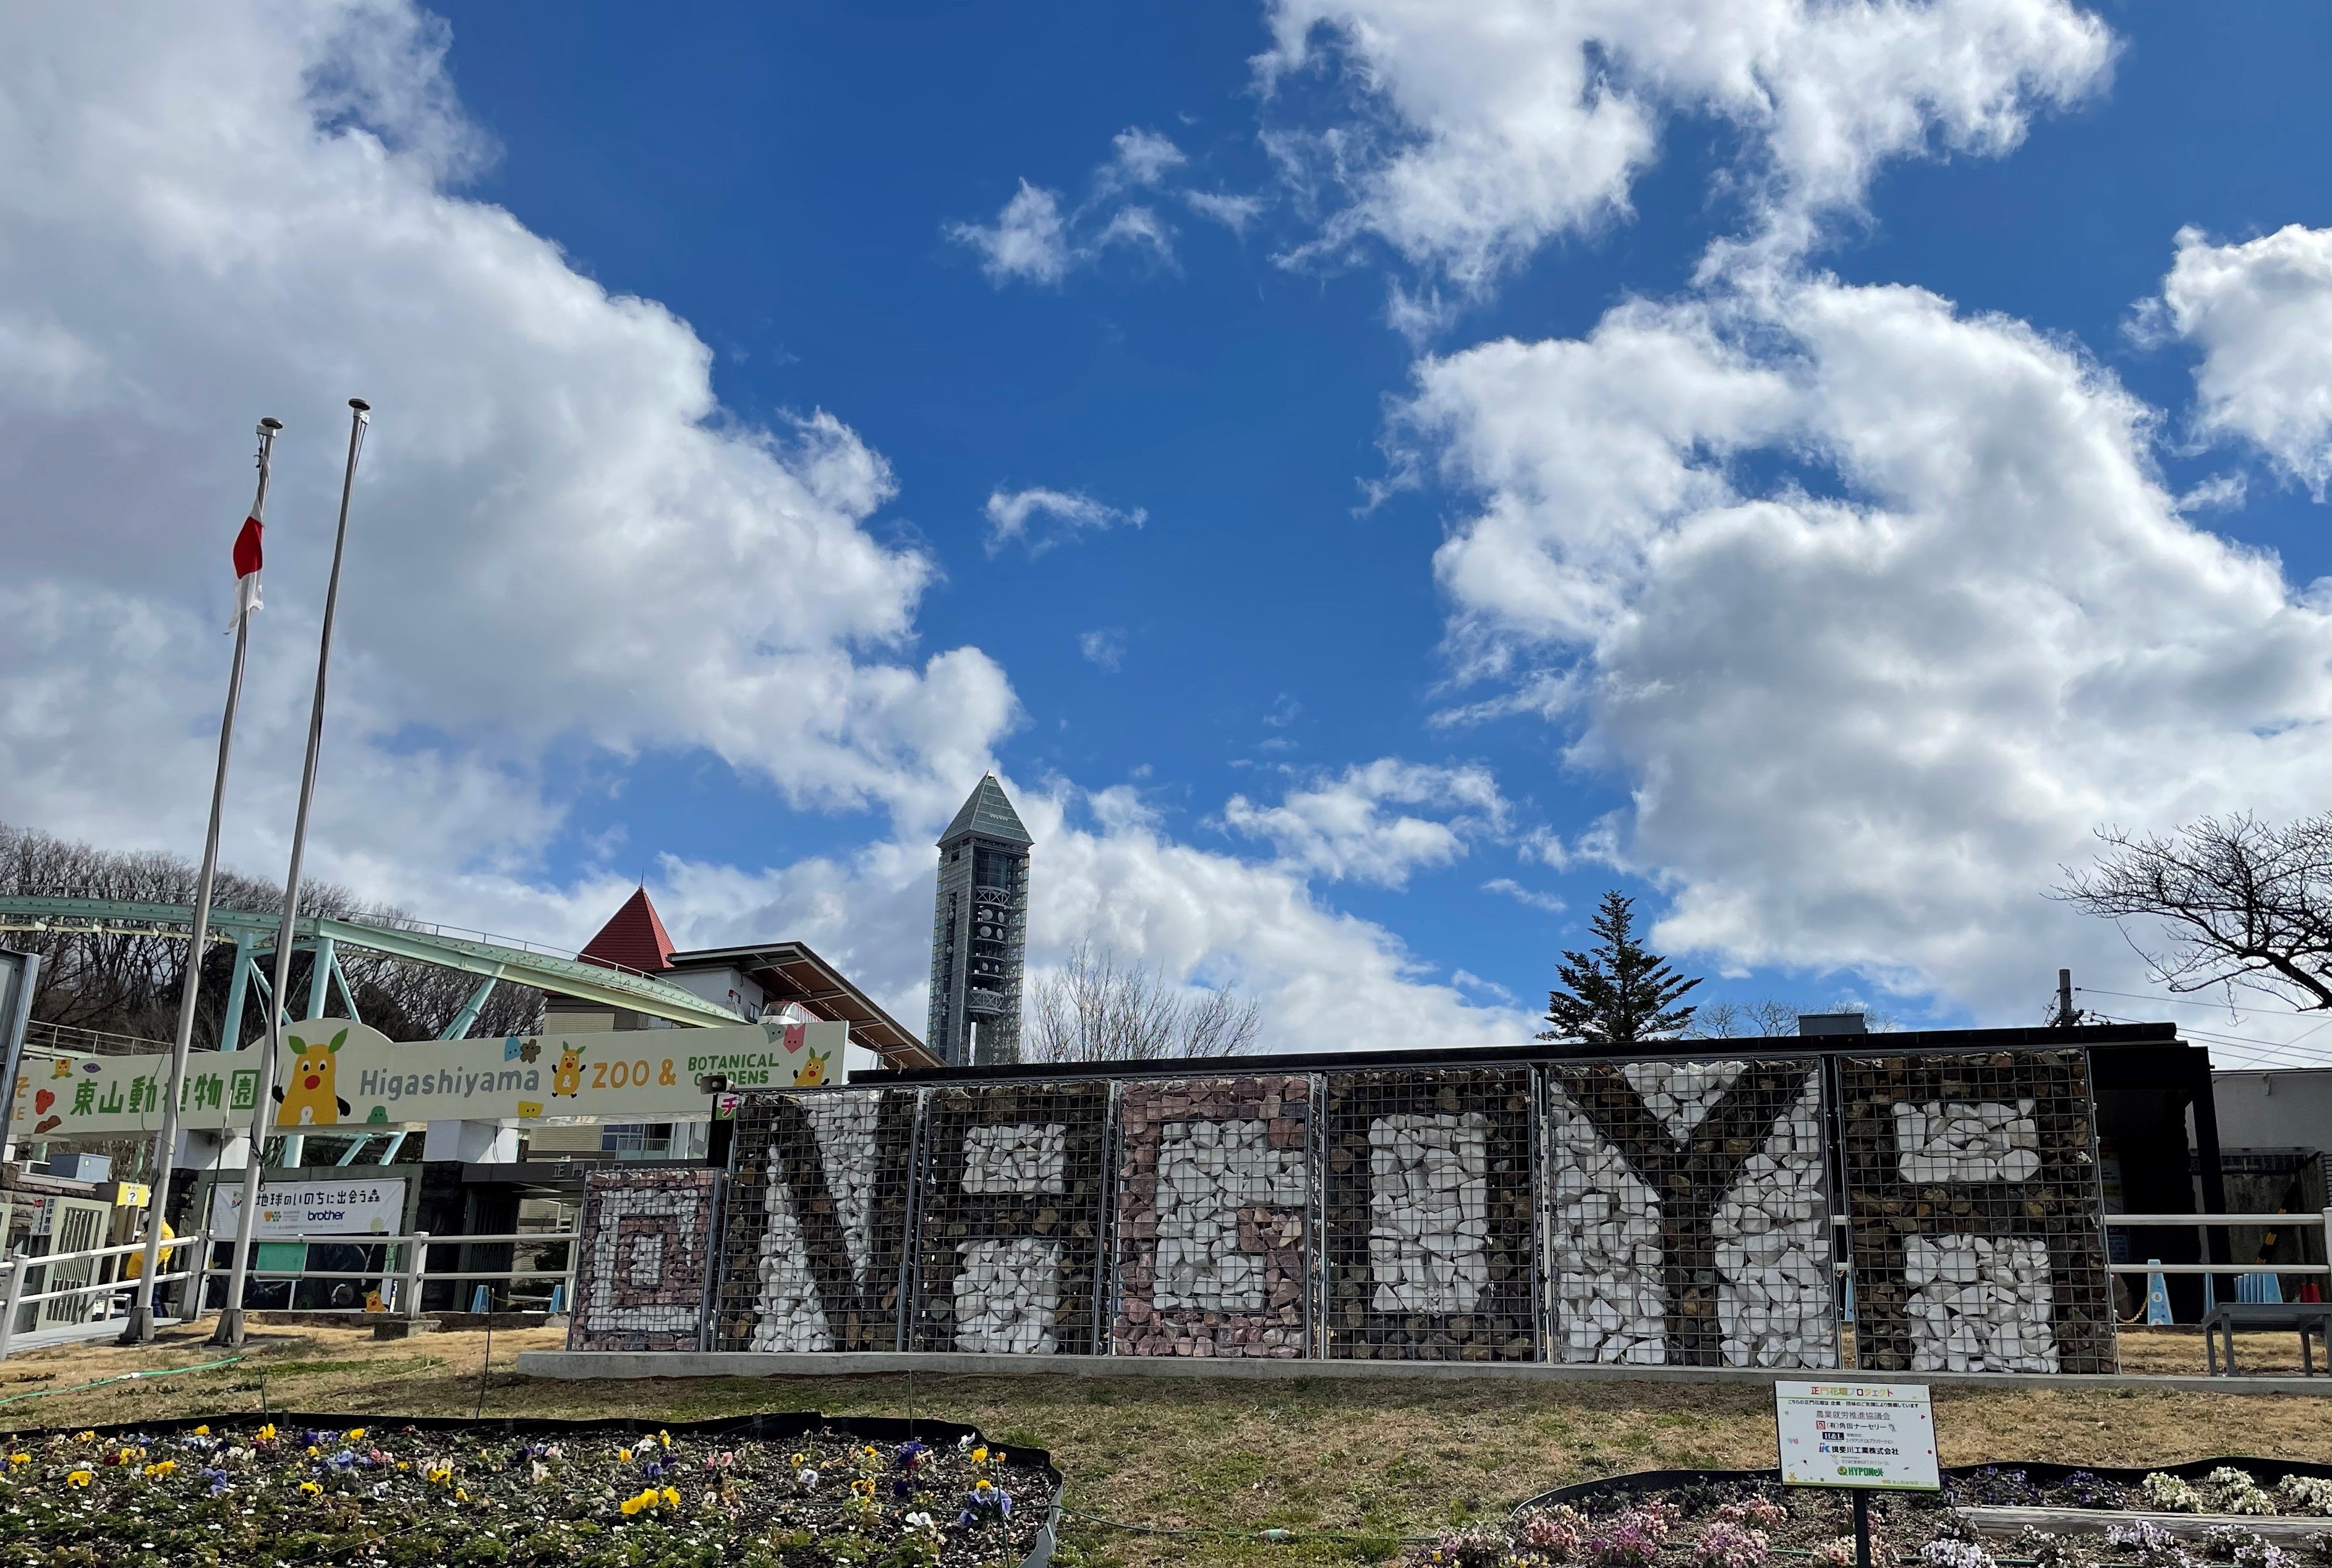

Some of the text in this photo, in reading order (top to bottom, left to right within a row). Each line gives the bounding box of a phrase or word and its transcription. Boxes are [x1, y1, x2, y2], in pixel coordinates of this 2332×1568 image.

[687, 1053, 780, 1071] BOTANICAL
[592, 1058, 676, 1088] ZOO &
[694, 1070, 769, 1087] GDENS
[359, 1066, 540, 1101] Higashiyama
[307, 1210, 345, 1221] brother
[1810, 1386, 1894, 1397] 正門花壇プロジェクト
[1816, 1410, 1891, 1420] 農業就労推進協議会
